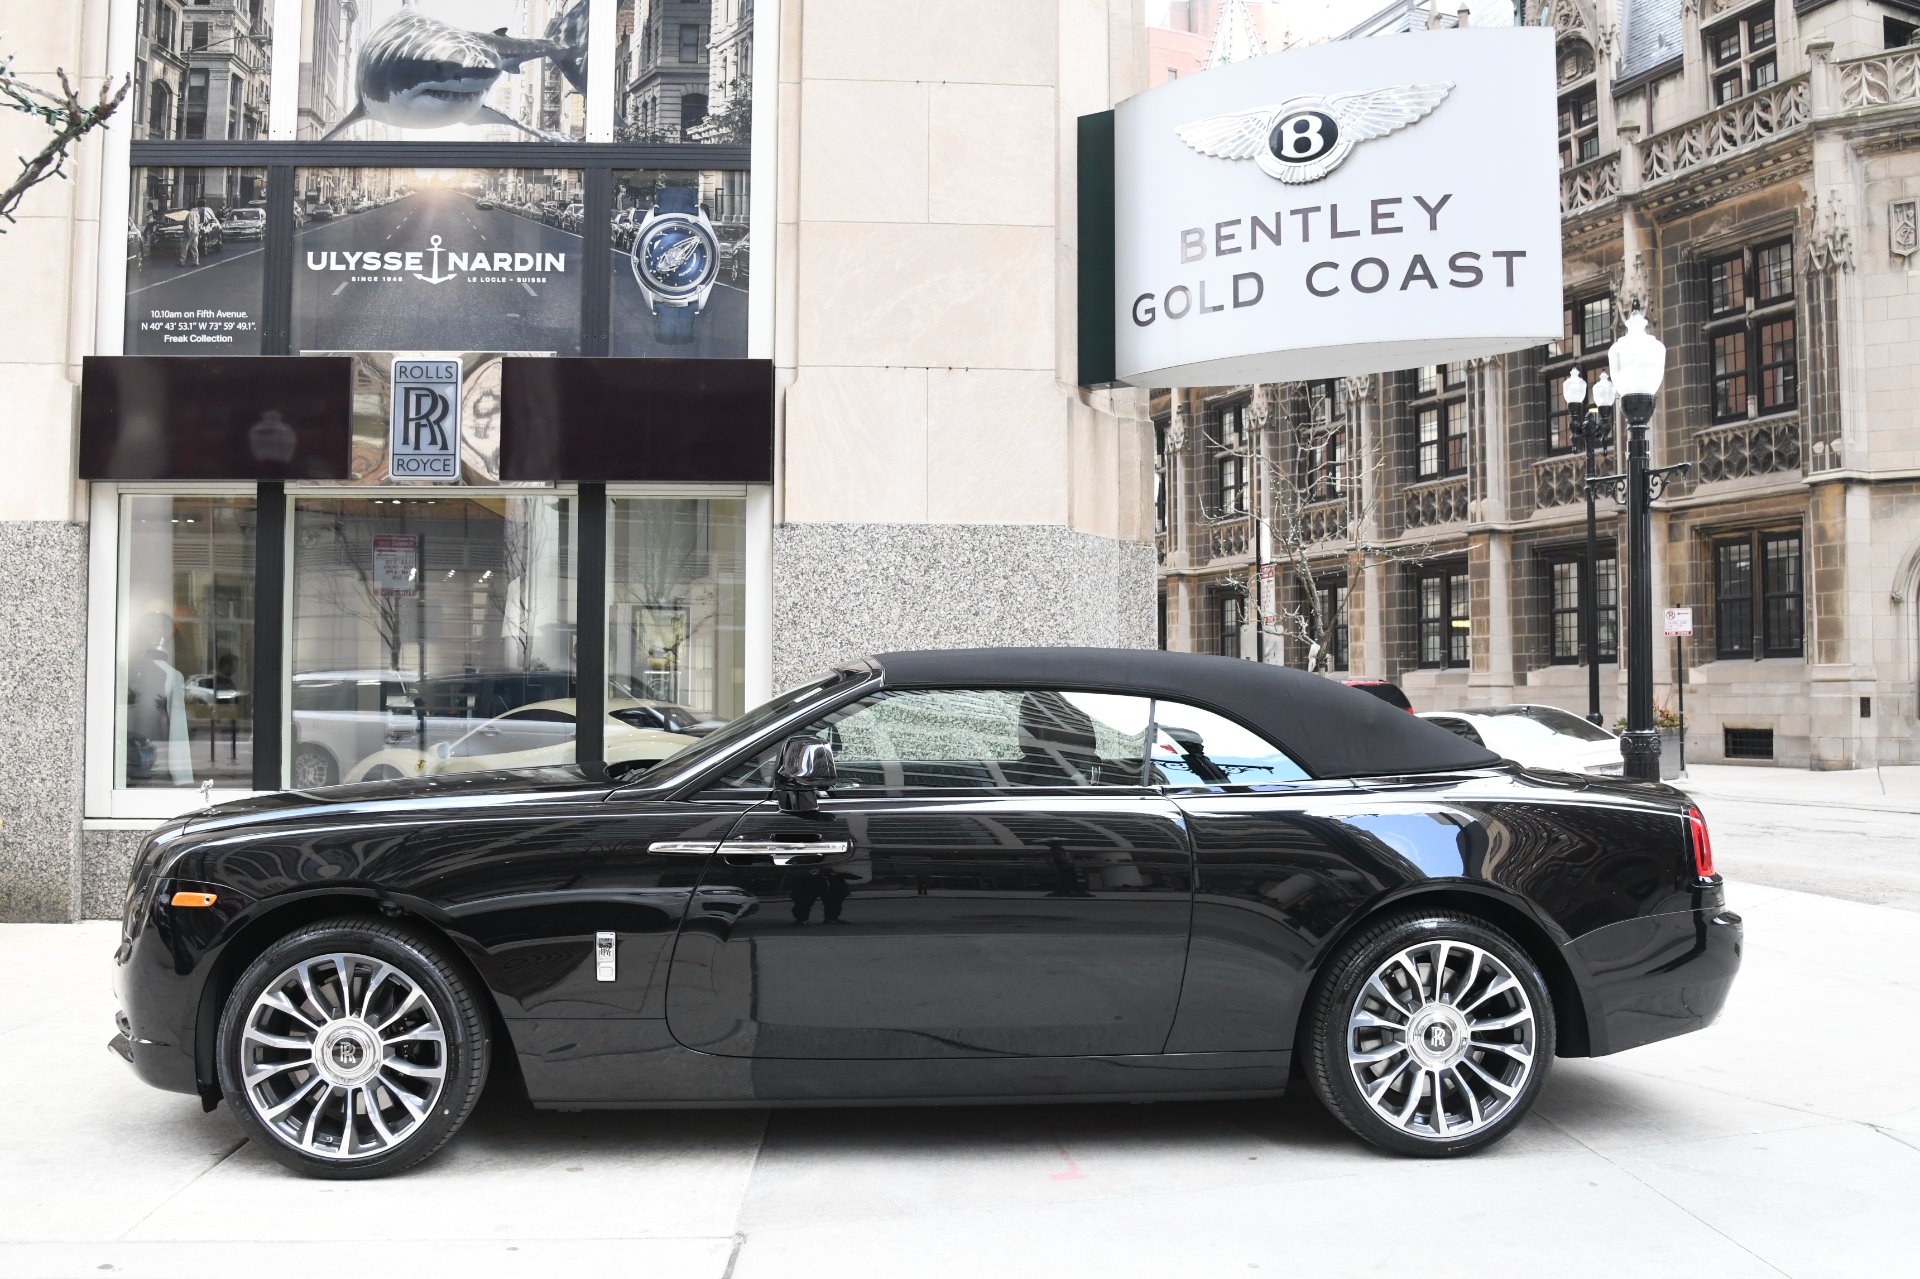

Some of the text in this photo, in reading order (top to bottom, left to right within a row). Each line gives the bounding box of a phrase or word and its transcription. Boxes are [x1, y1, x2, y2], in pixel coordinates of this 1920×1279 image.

[1279, 115, 1324, 159] B
[1180, 193, 1453, 264] BENTLEY
[307, 251, 566, 272] ULYSSE NARDIN
[1132, 250, 1527, 328] GOLD COAST
[150, 310, 182, 318] 10.10am
[196, 309, 215, 318] Fifth
[216, 310, 248, 318] Avenue.
[141, 322, 148, 330] N
[198, 322, 207, 330] W
[164, 334, 233, 342] Freak Collection
[399, 365, 453, 379] ROLLS
[396, 458, 451, 472] ROYCE
